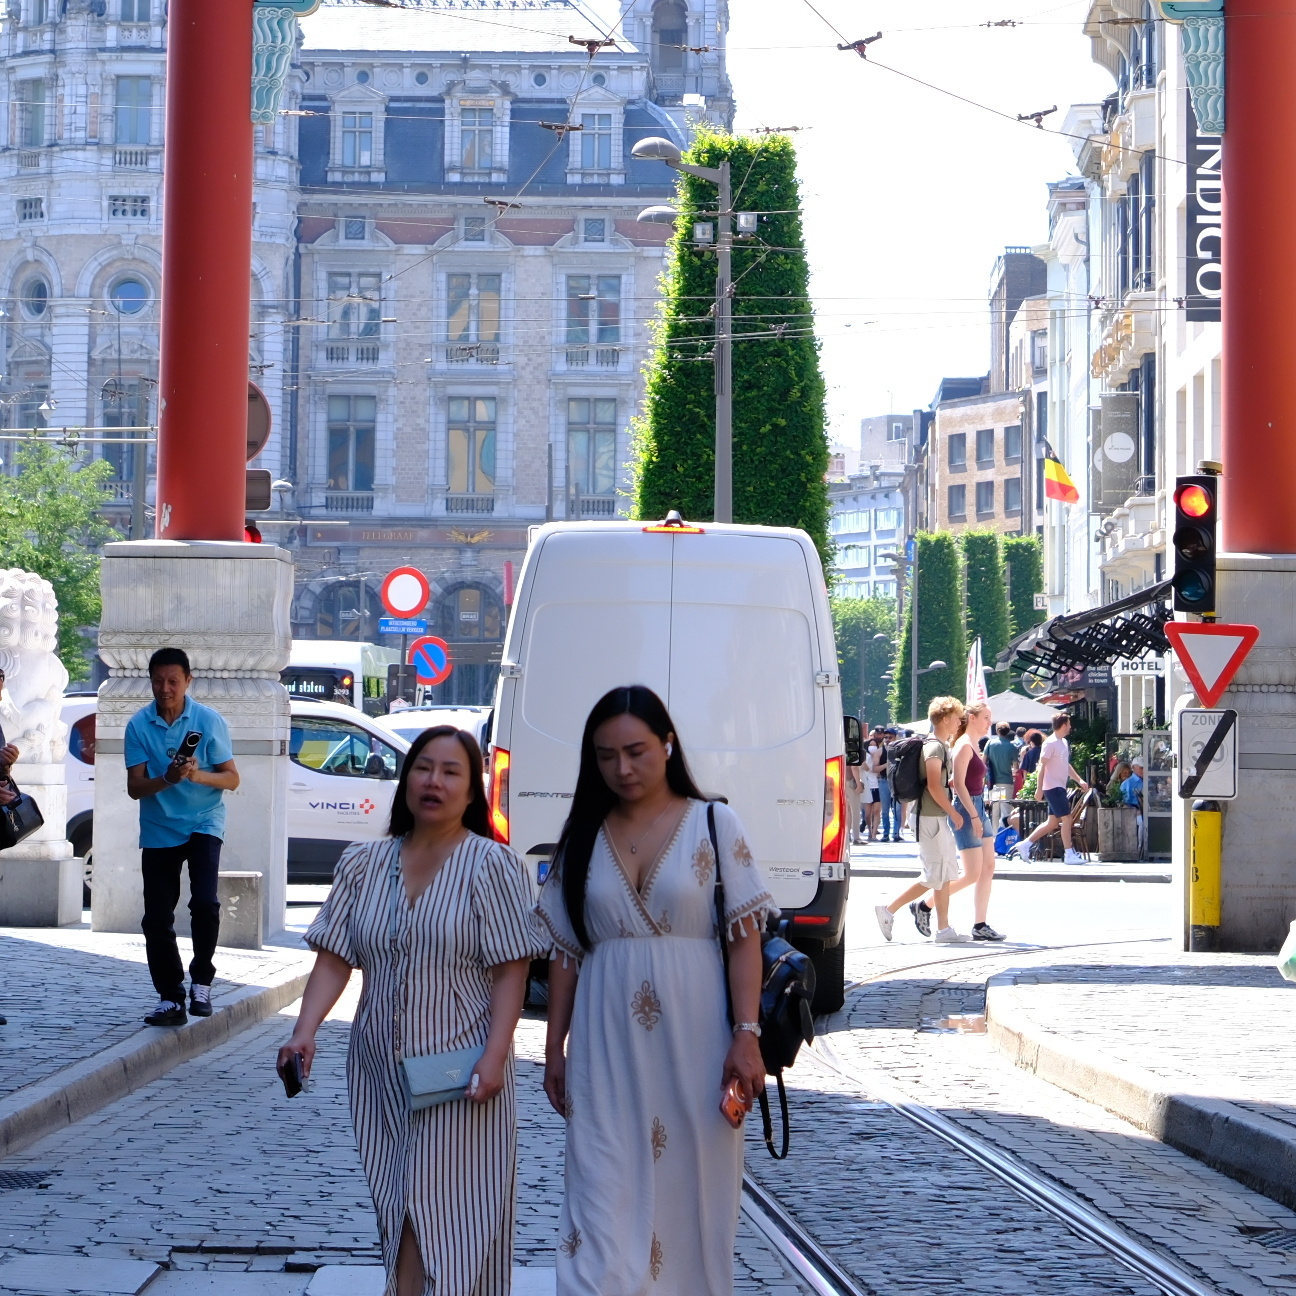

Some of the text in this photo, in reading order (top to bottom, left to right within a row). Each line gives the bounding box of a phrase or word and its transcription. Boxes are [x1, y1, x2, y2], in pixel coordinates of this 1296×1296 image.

[362, 531, 414, 541] TELEGRAAF
[1121, 661, 1162, 671] HOTEL
[308, 801, 355, 810] VINCI
